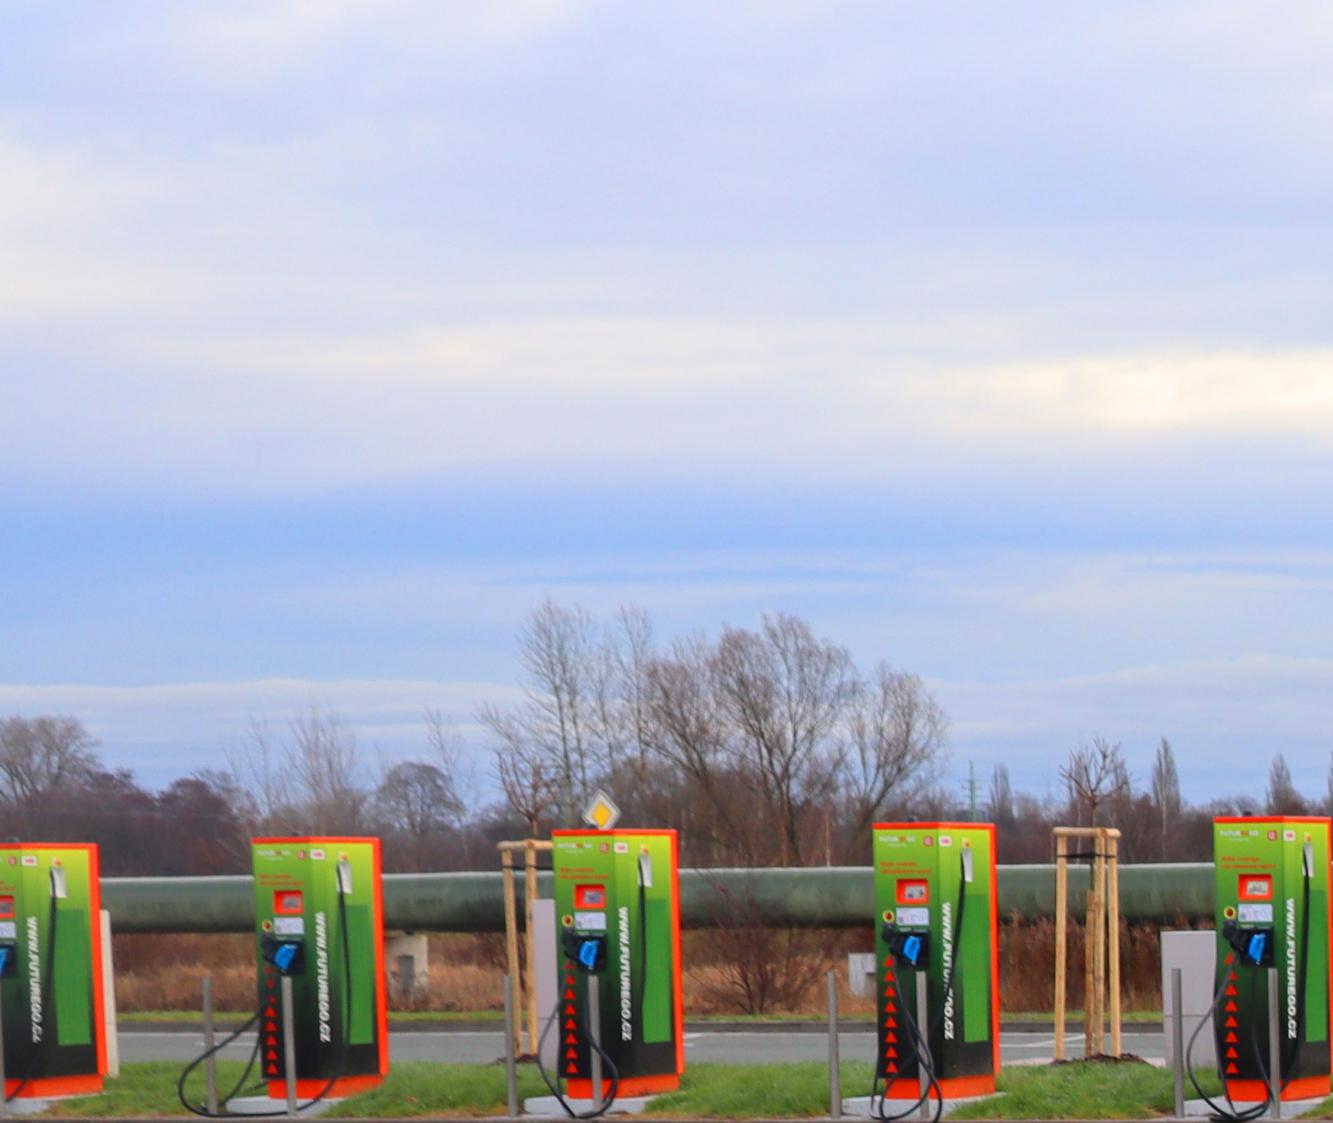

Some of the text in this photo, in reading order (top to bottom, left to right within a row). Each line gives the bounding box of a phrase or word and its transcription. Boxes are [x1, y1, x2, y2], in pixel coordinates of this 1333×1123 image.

[315, 911, 331, 1043] WWW.FUTUREGO.CZ
[617, 906, 632, 1041] WWW.FUTUREGO.CZ
[1286, 897, 1297, 1039] WWW.FUTUREGO.CZ
